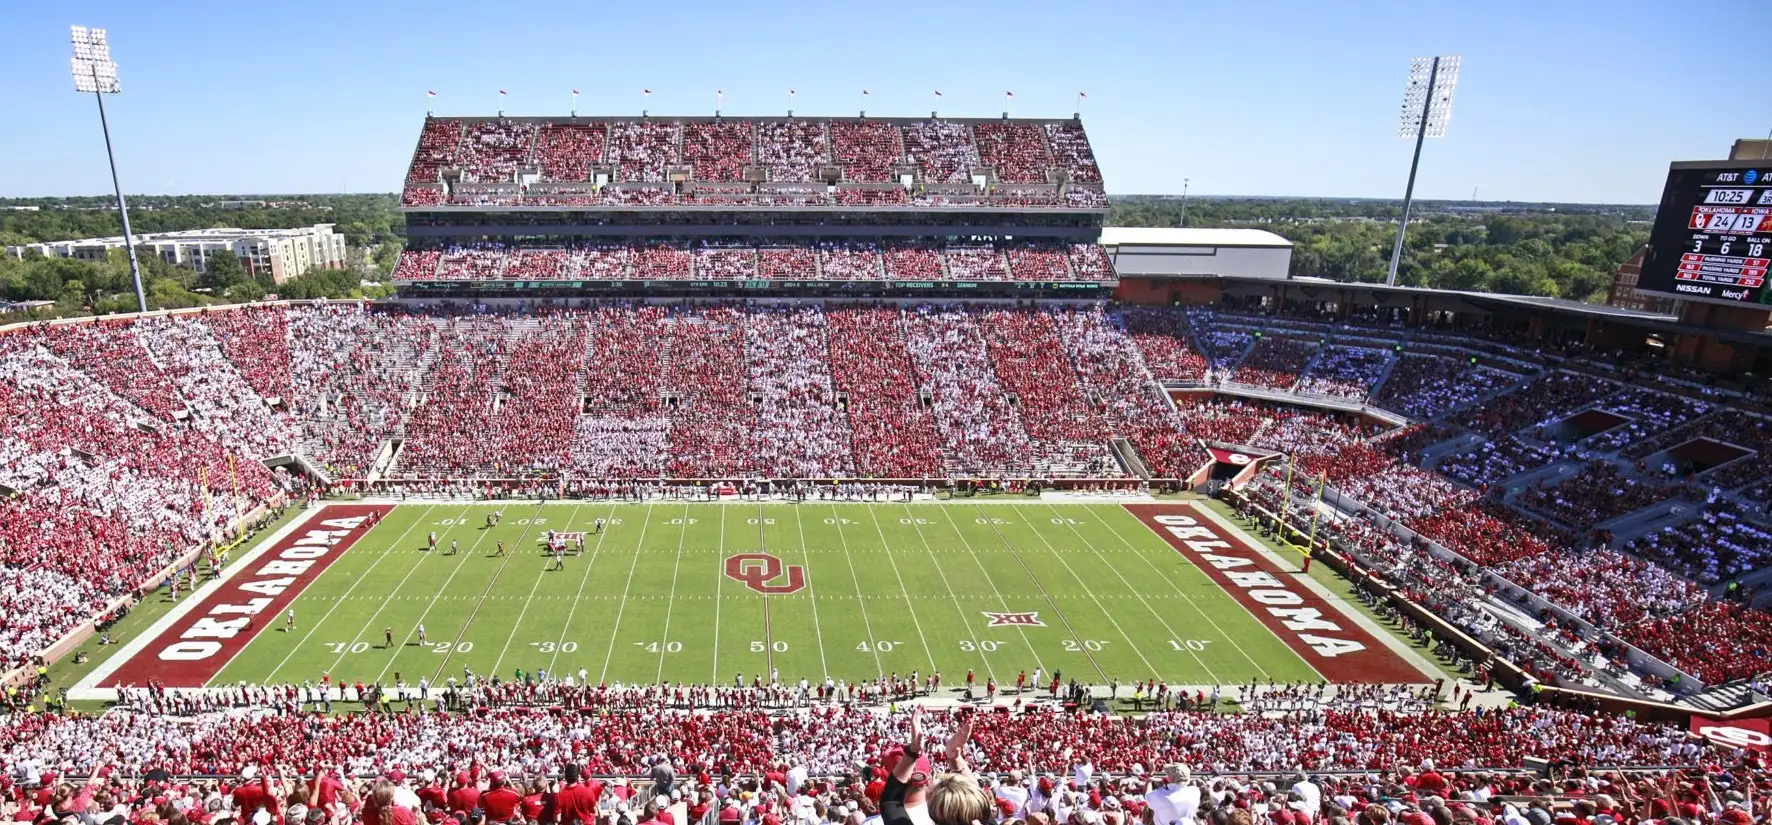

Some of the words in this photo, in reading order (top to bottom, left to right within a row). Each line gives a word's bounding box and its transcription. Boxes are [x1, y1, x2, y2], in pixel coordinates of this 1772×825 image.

[1717, 173, 1739, 181] AT&T
[1713, 191, 1744, 202] 10:25
[1714, 216, 1729, 227] 24
[1741, 216, 1755, 228] 13
[1692, 241, 1702, 252] 3
[1720, 242, 1731, 254] 6
[1748, 244, 1763, 256] 18
[1676, 285, 1711, 294] NISSAN
[1722, 289, 1744, 300] Mercy
[724, 552, 807, 595] OU
[158, 515, 368, 661] OKLAHOMA
[1153, 515, 1368, 658] OKLAHOMA
[330, 641, 370, 654] 10
[432, 641, 474, 653] 20
[539, 641, 578, 653] 30
[645, 641, 683, 653] 40
[750, 641, 789, 652] 50
[856, 641, 893, 652] 40
[959, 640, 997, 652] 30
[1061, 640, 1102, 652] 20
[1168, 640, 1205, 651] 10
